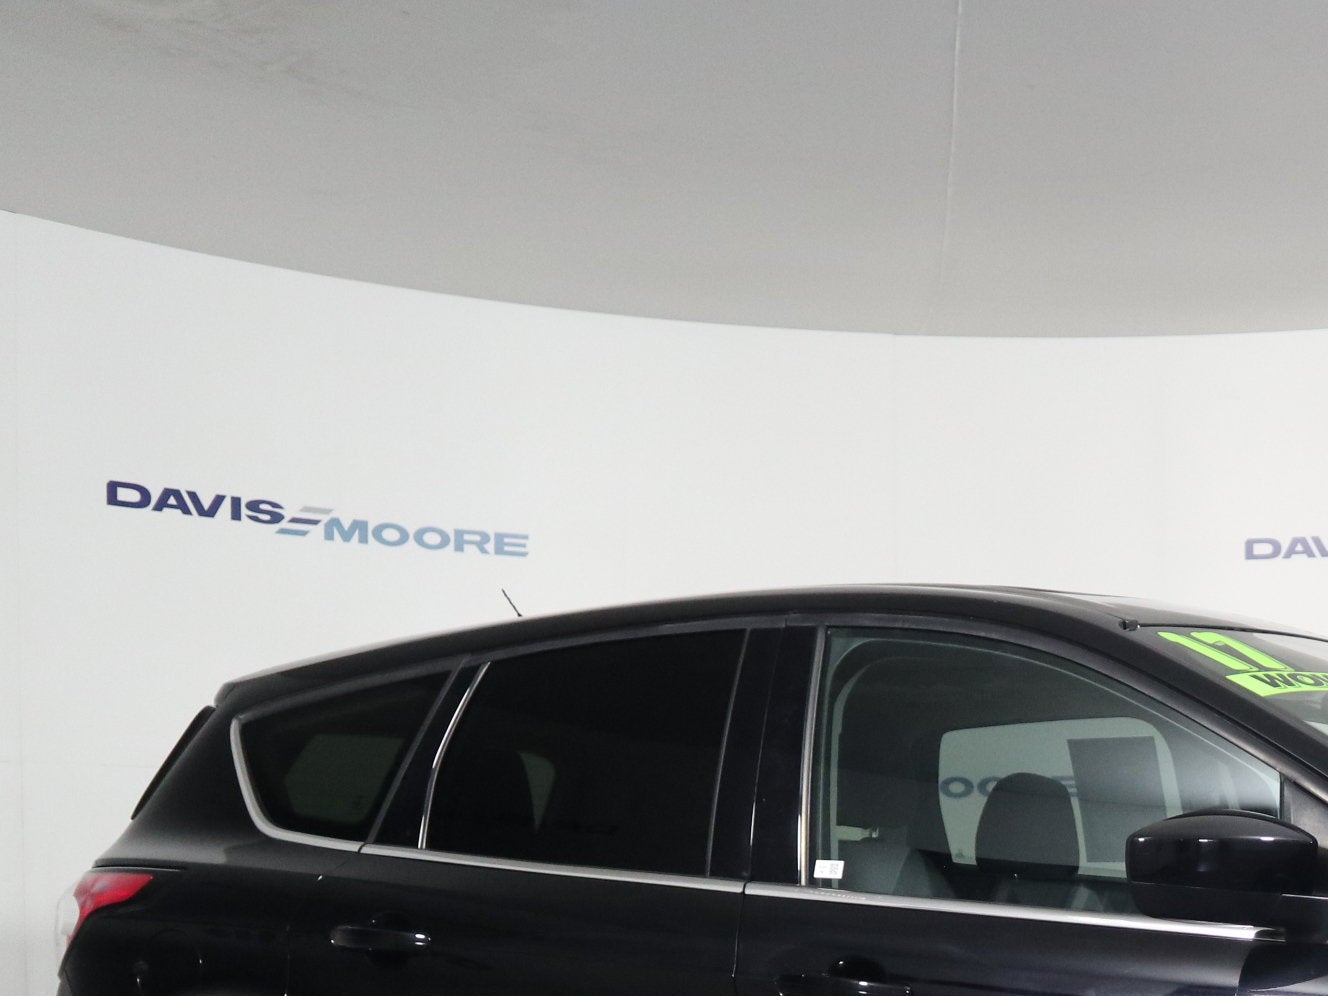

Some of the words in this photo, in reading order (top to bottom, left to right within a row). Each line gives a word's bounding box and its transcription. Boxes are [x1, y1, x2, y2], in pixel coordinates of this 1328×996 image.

[106, 480, 286, 525] DAVIS
[323, 516, 530, 558] MOORE
[1156, 631, 1294, 672] 17
